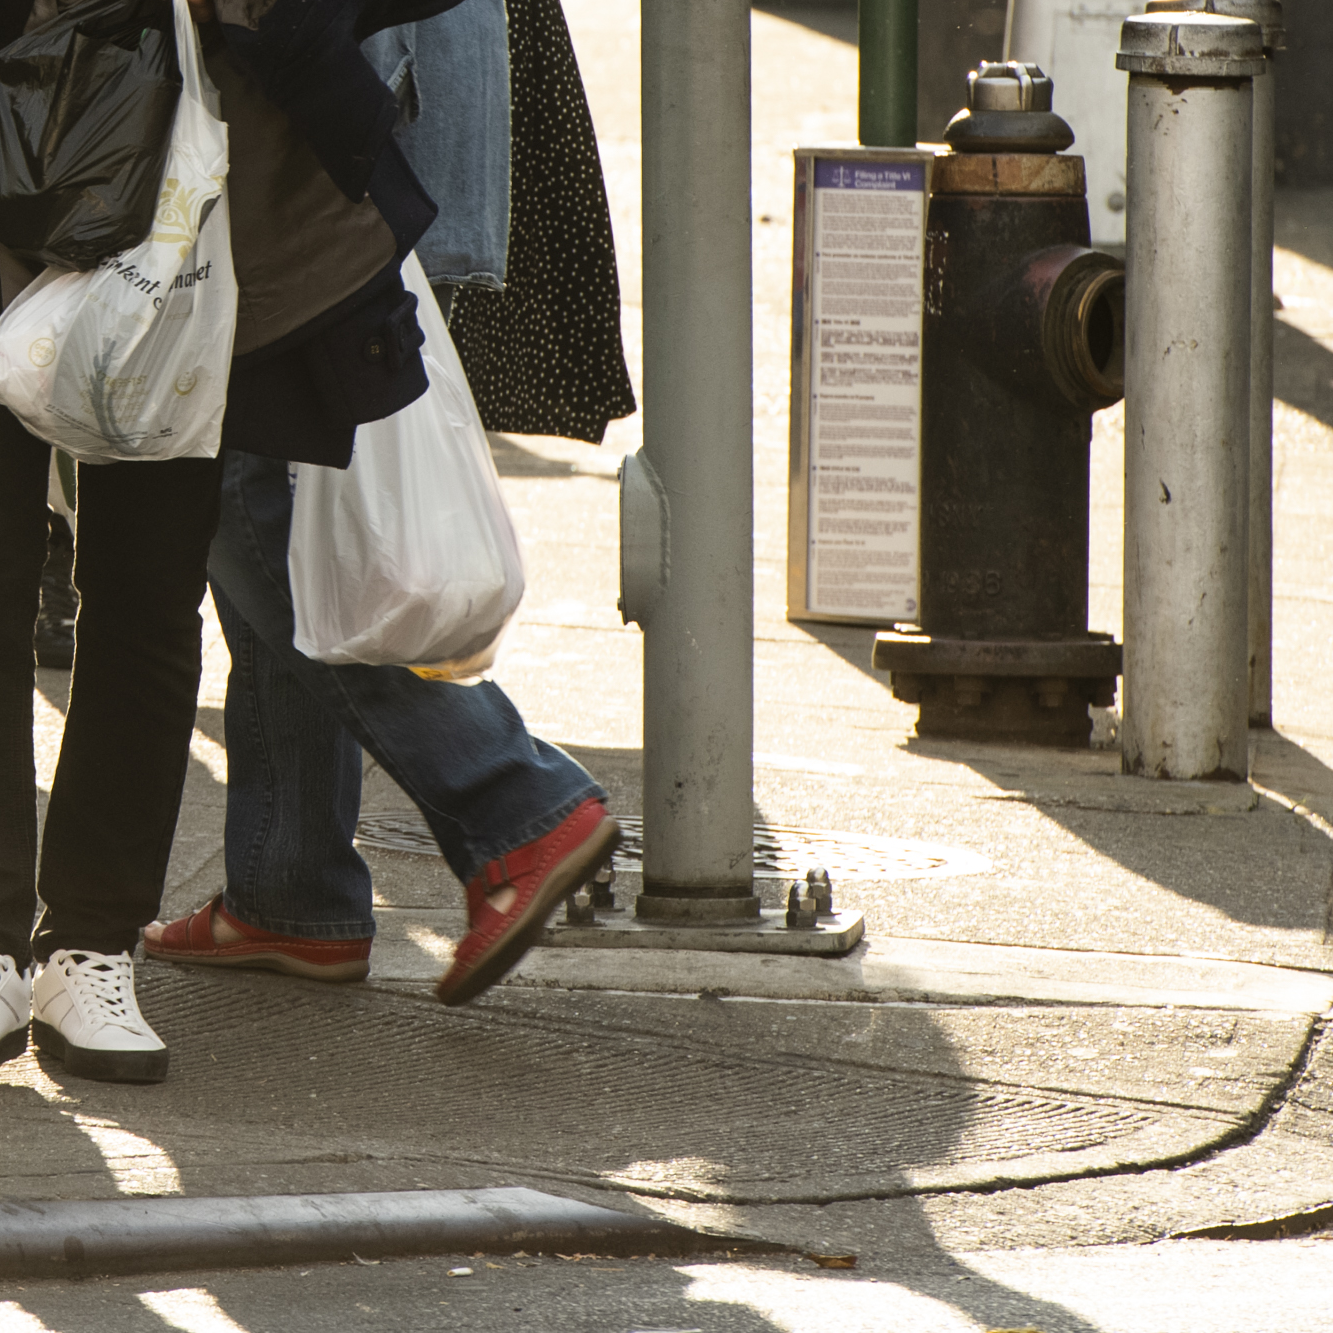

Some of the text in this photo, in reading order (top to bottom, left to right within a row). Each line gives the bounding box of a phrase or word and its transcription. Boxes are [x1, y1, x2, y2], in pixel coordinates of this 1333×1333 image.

[854, 170, 876, 181] Filing
[884, 170, 901, 181] Title
[854, 180, 896, 190] Complaint
